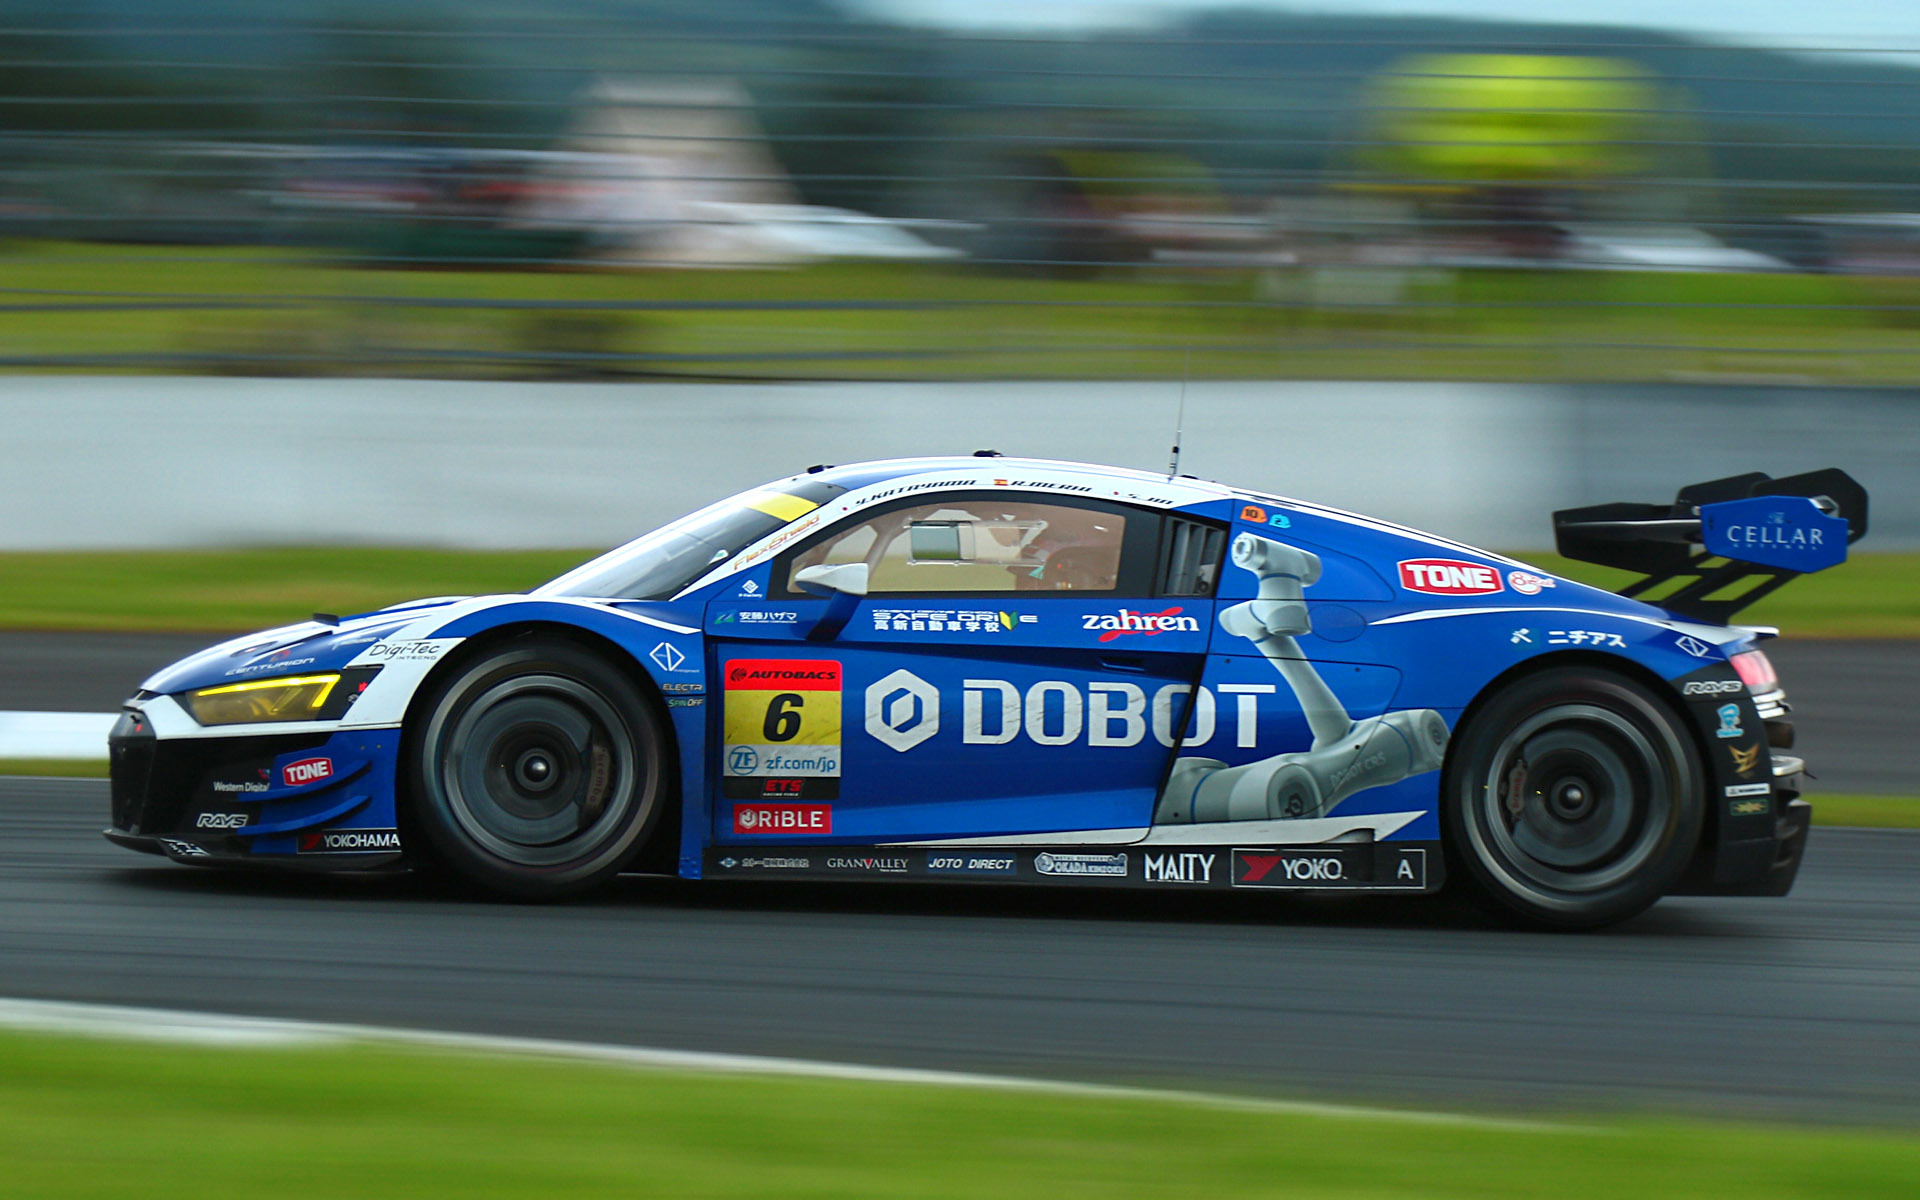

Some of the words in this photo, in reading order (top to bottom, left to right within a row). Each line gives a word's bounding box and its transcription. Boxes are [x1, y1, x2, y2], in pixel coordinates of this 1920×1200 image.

[1727, 525, 1824, 545] CELLAR
[1406, 564, 1496, 589] TONE
[872, 612, 949, 621] SAFE
[1082, 609, 1200, 631] zahren
[1548, 630, 1627, 648] ニチアス
[369, 642, 441, 660] Digi-Tec
[748, 671, 837, 680] AUTOBACS
[1683, 681, 1743, 695] RAYS
[763, 693, 804, 742] 6
[963, 679, 1277, 748] DOBOT
[731, 752, 757, 770] ZF
[766, 756, 836, 772] zf.com/jp
[286, 760, 330, 782] TONE
[214, 782, 244, 792] Western
[245, 782, 270, 792] Digital
[764, 779, 803, 792] ETS
[197, 813, 248, 828] RAYS
[324, 834, 401, 847] YOKOHAMA
[826, 858, 909, 870] GRANVALLEY
[929, 858, 963, 869] JOTO
[968, 859, 1013, 869] DIRECT
[1055, 862, 1088, 873] OKADA
[1145, 853, 1216, 881] MAITY
